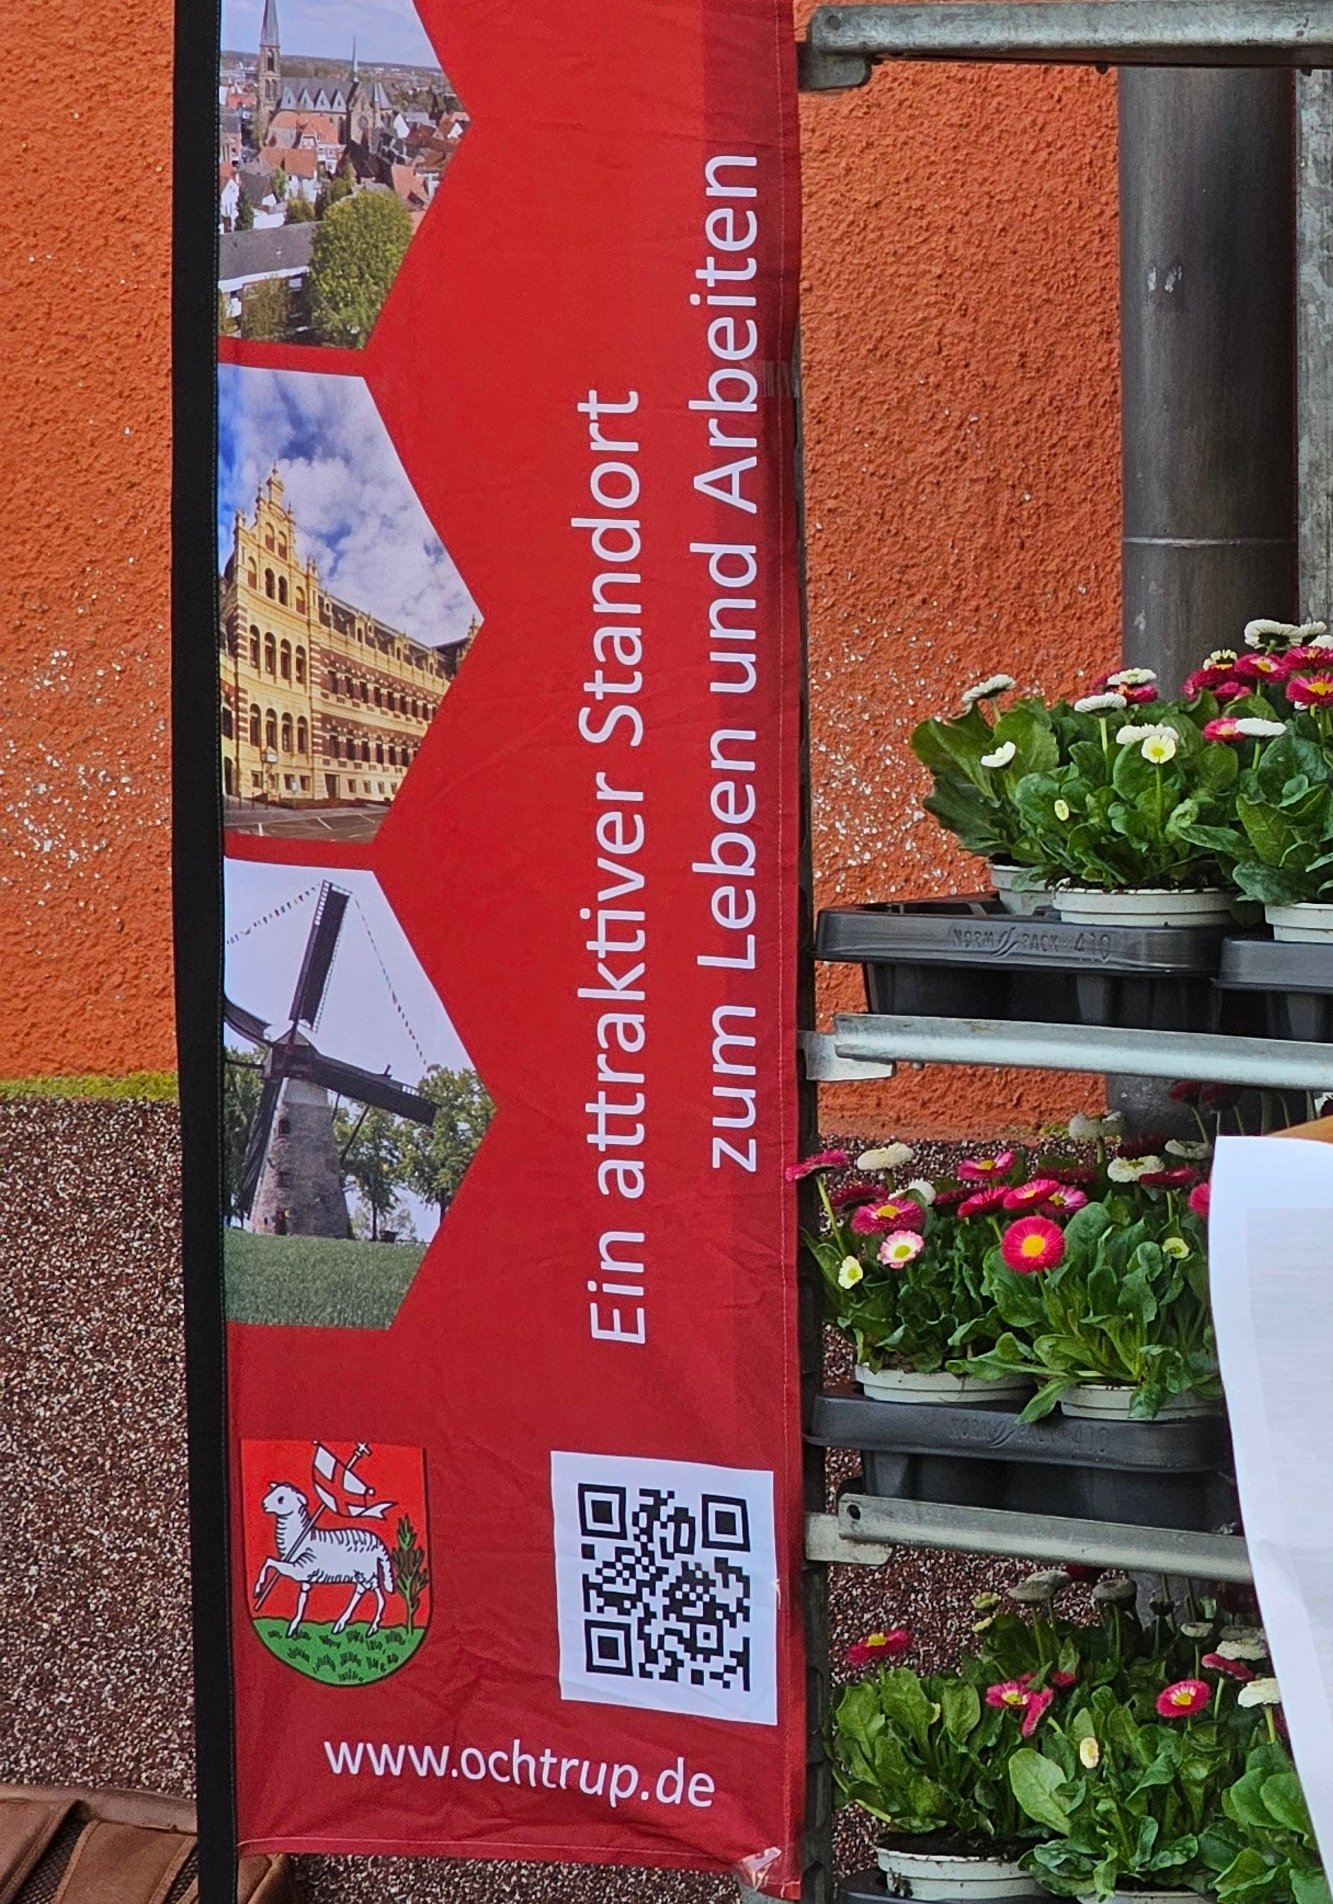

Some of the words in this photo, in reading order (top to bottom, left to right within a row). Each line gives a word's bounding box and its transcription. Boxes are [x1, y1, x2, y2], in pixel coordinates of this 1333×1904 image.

[688, 155, 759, 514] Arbeiten
[570, 389, 644, 747] Standort
[689, 542, 758, 694] und
[691, 729, 758, 970] Leben
[577, 771, 646, 1199] attraktiver
[711, 1005, 758, 1173] zum
[587, 1231, 646, 1345] Ein
[322, 1738, 716, 1810] www.ochtrup.de
